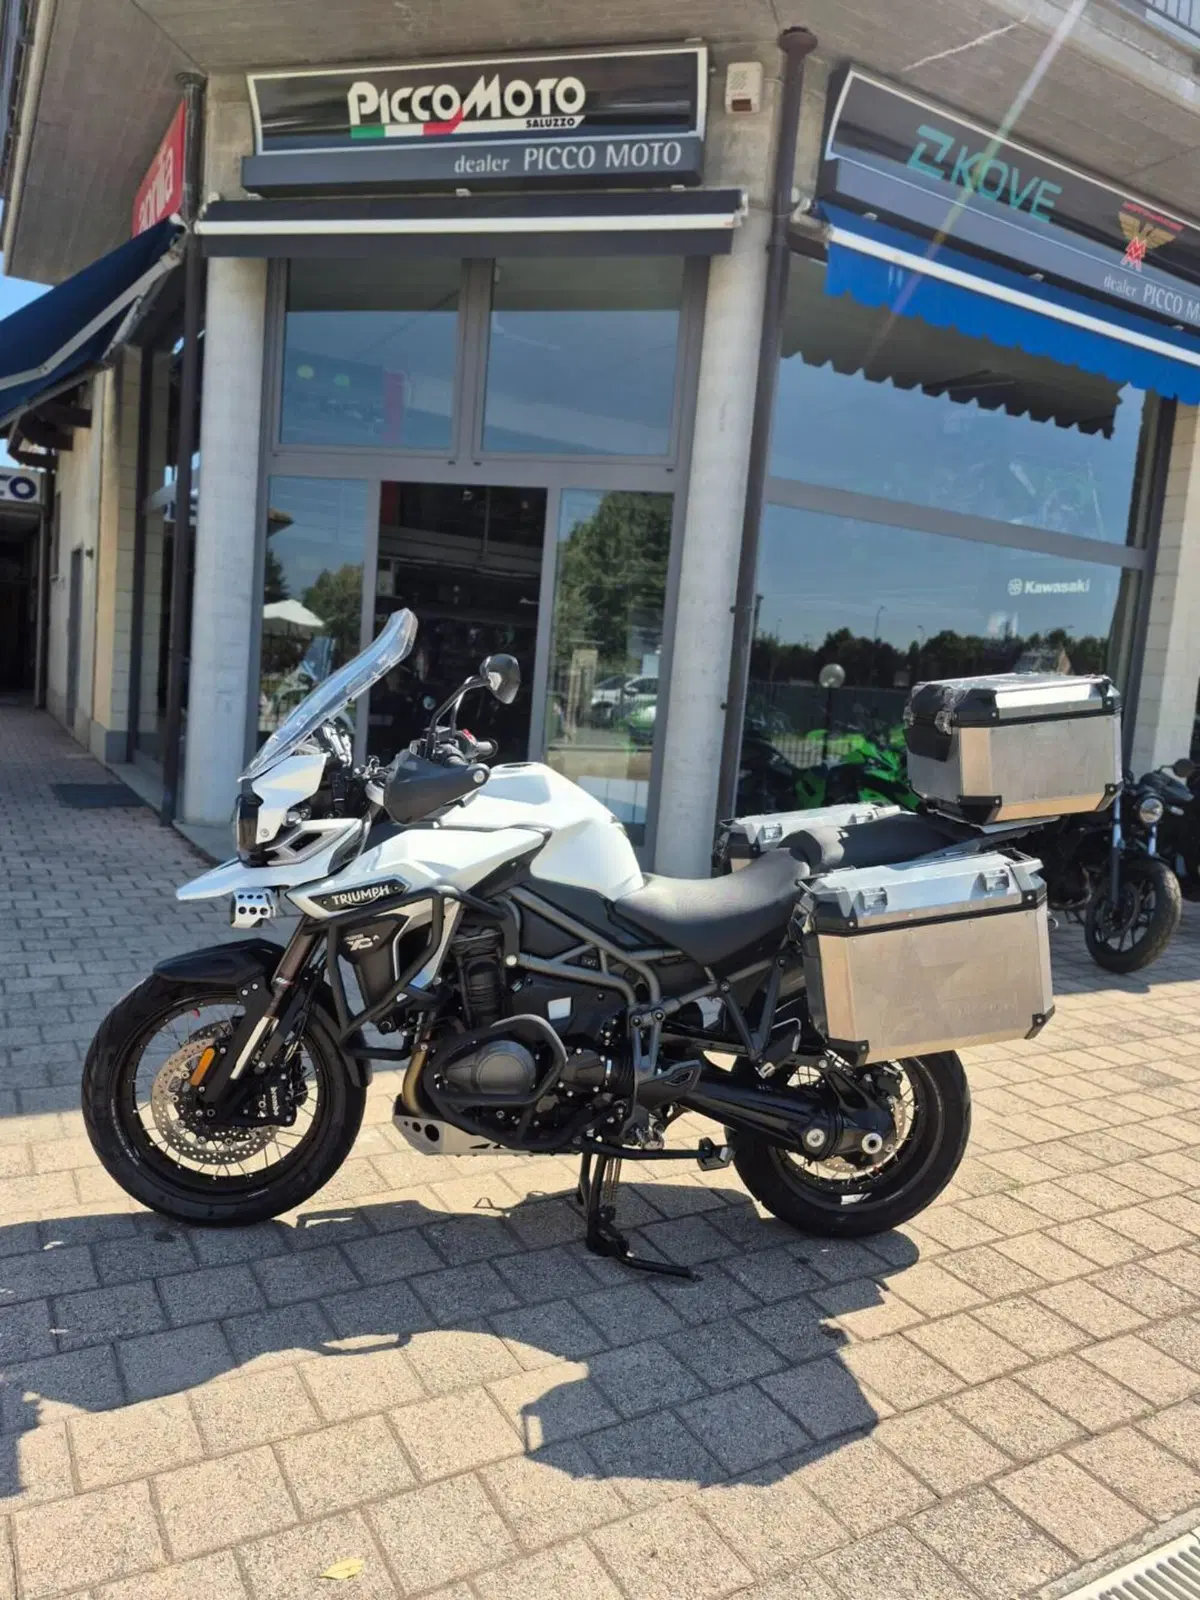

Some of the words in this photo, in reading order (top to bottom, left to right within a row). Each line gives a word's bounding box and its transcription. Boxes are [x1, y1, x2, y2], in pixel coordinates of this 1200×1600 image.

[525, 117, 576, 129] SALUZZO
[453, 154, 510, 174] dealer
[524, 145, 596, 172] PICCO
[605, 141, 682, 169] MOTO
[1103, 273, 1137, 298] dealer
[1142, 283, 1183, 315] PICCO
[1024, 577, 1091, 594] Kawasaki
[331, 884, 390, 906] TRIUMPH
